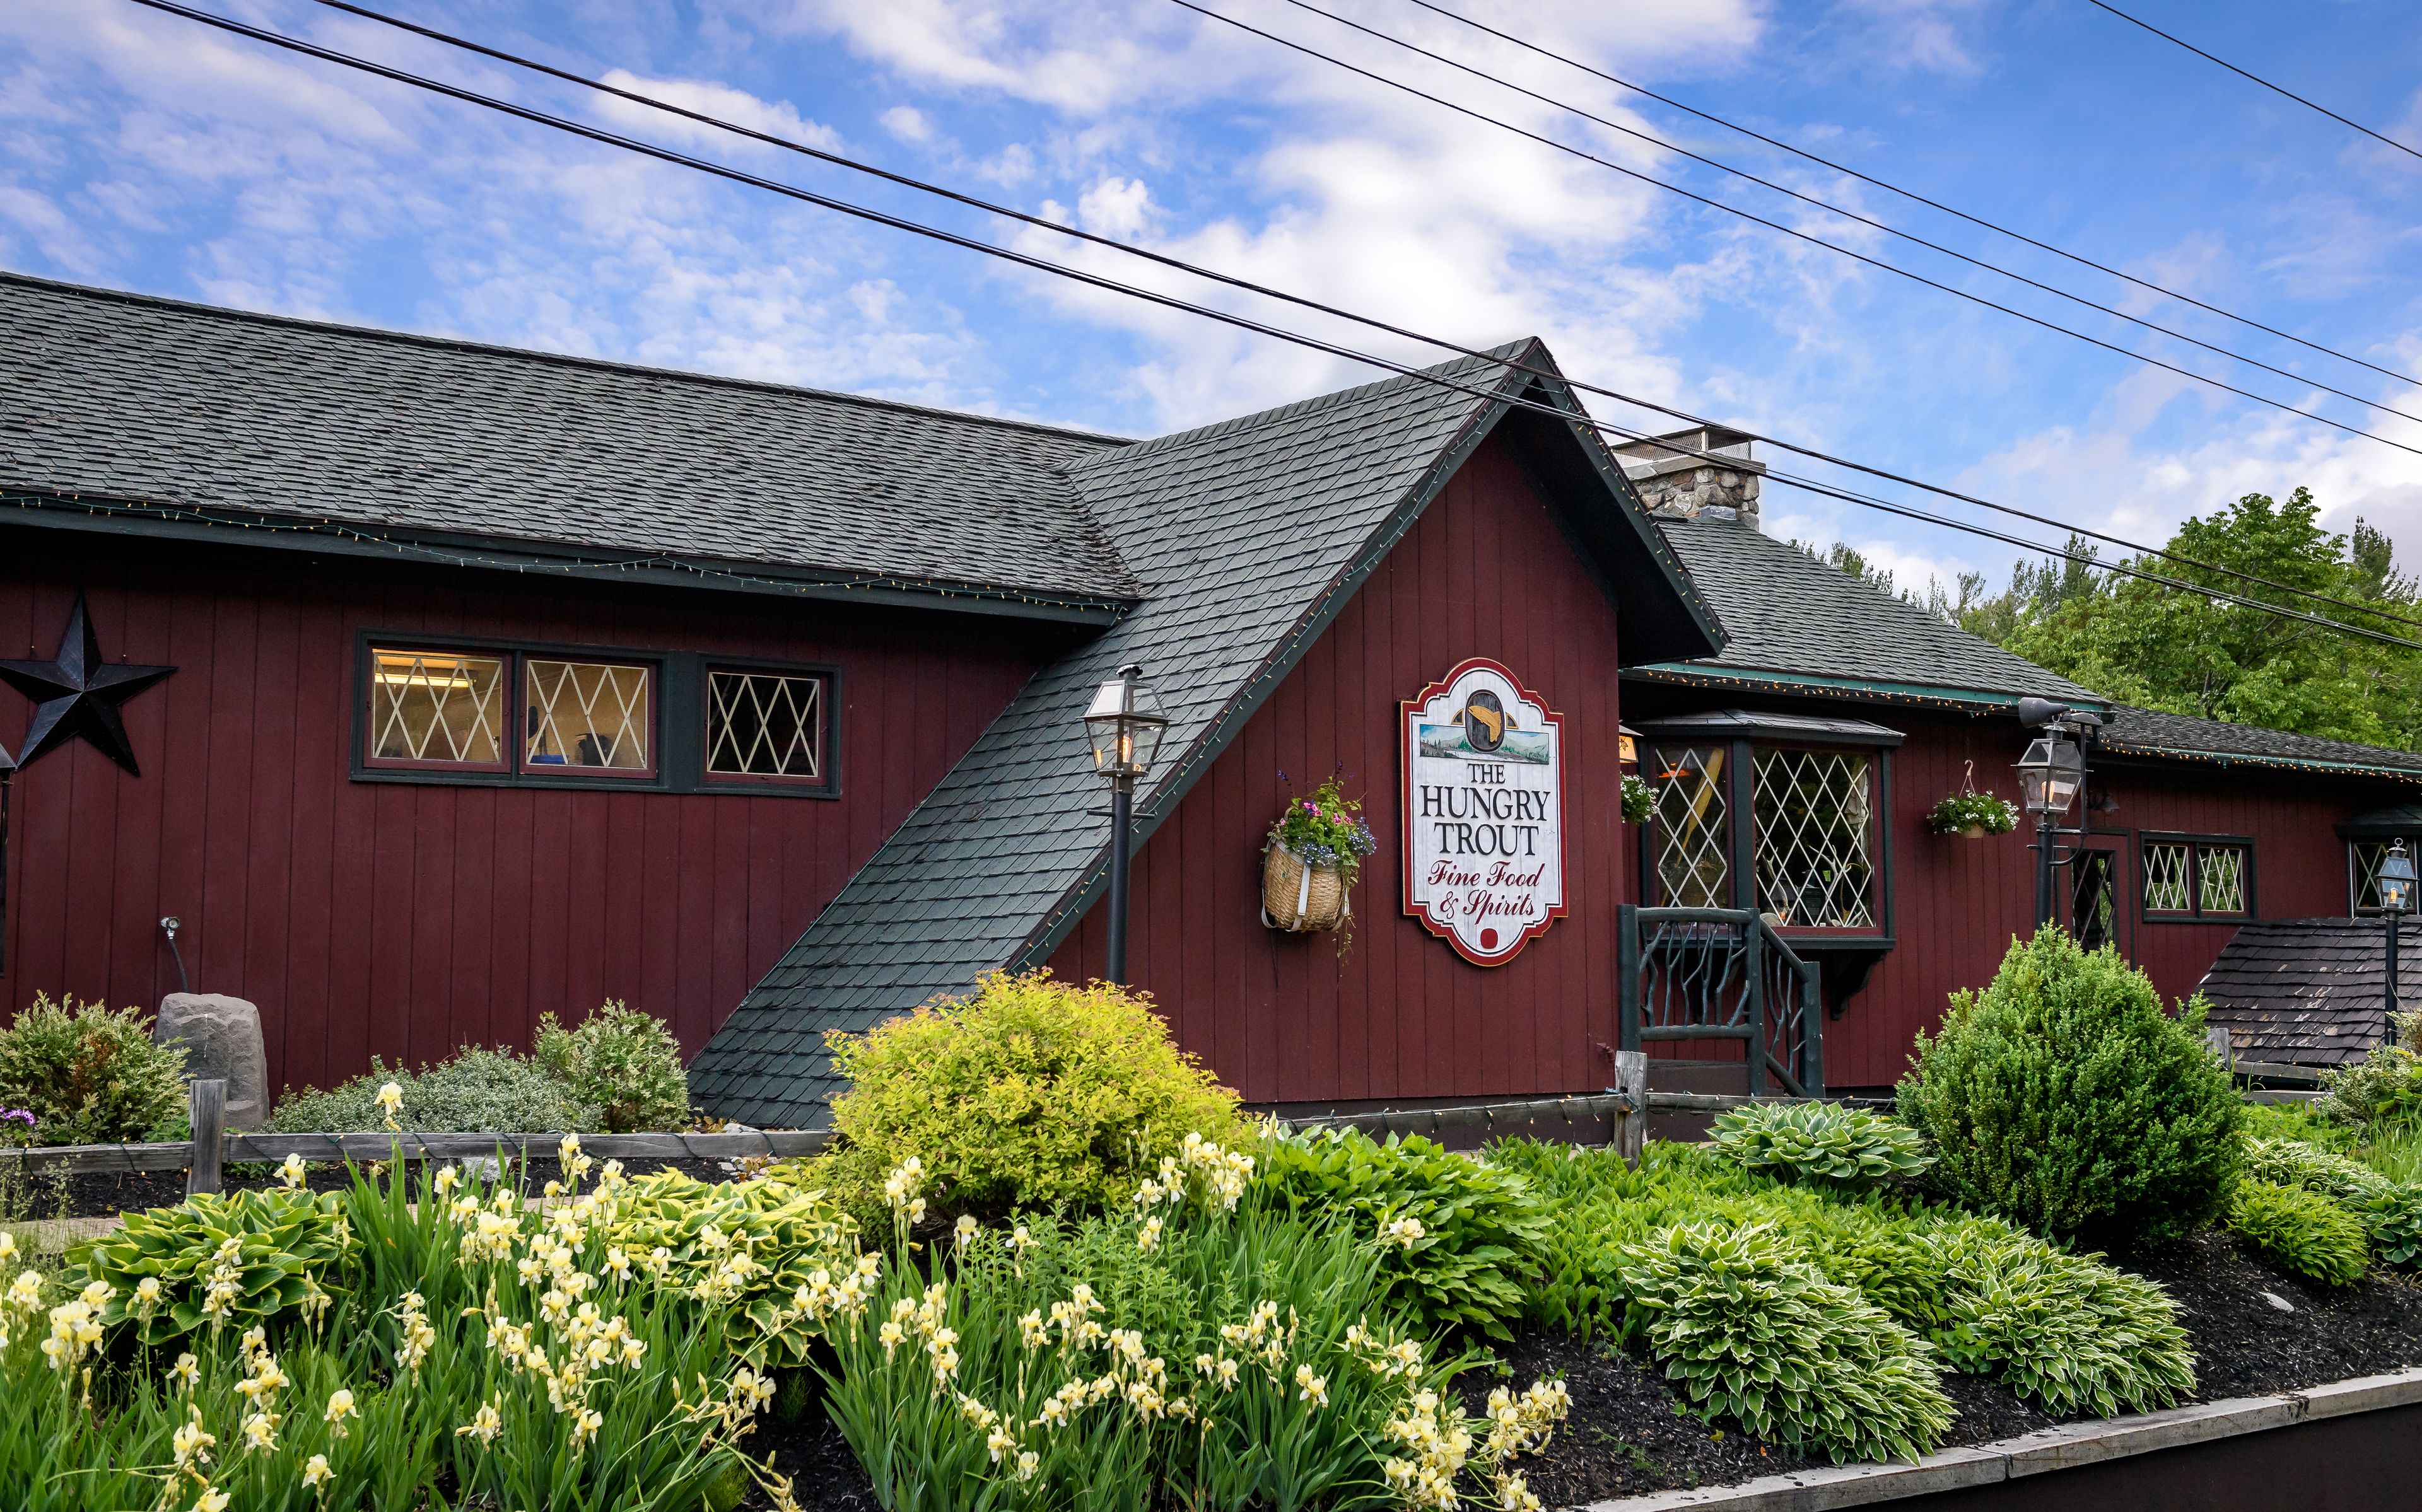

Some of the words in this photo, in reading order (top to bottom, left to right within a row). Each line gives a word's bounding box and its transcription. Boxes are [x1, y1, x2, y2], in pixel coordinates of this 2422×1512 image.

[1467, 764, 1506, 784] THE
[1420, 784, 1550, 821] HUNGRY
[1434, 822, 1539, 856] TROUT
[1428, 859, 1480, 886] Fine
[1487, 861, 1545, 887] Food
[1440, 890, 1458, 918] &
[1463, 889, 1535, 924] Spirits
